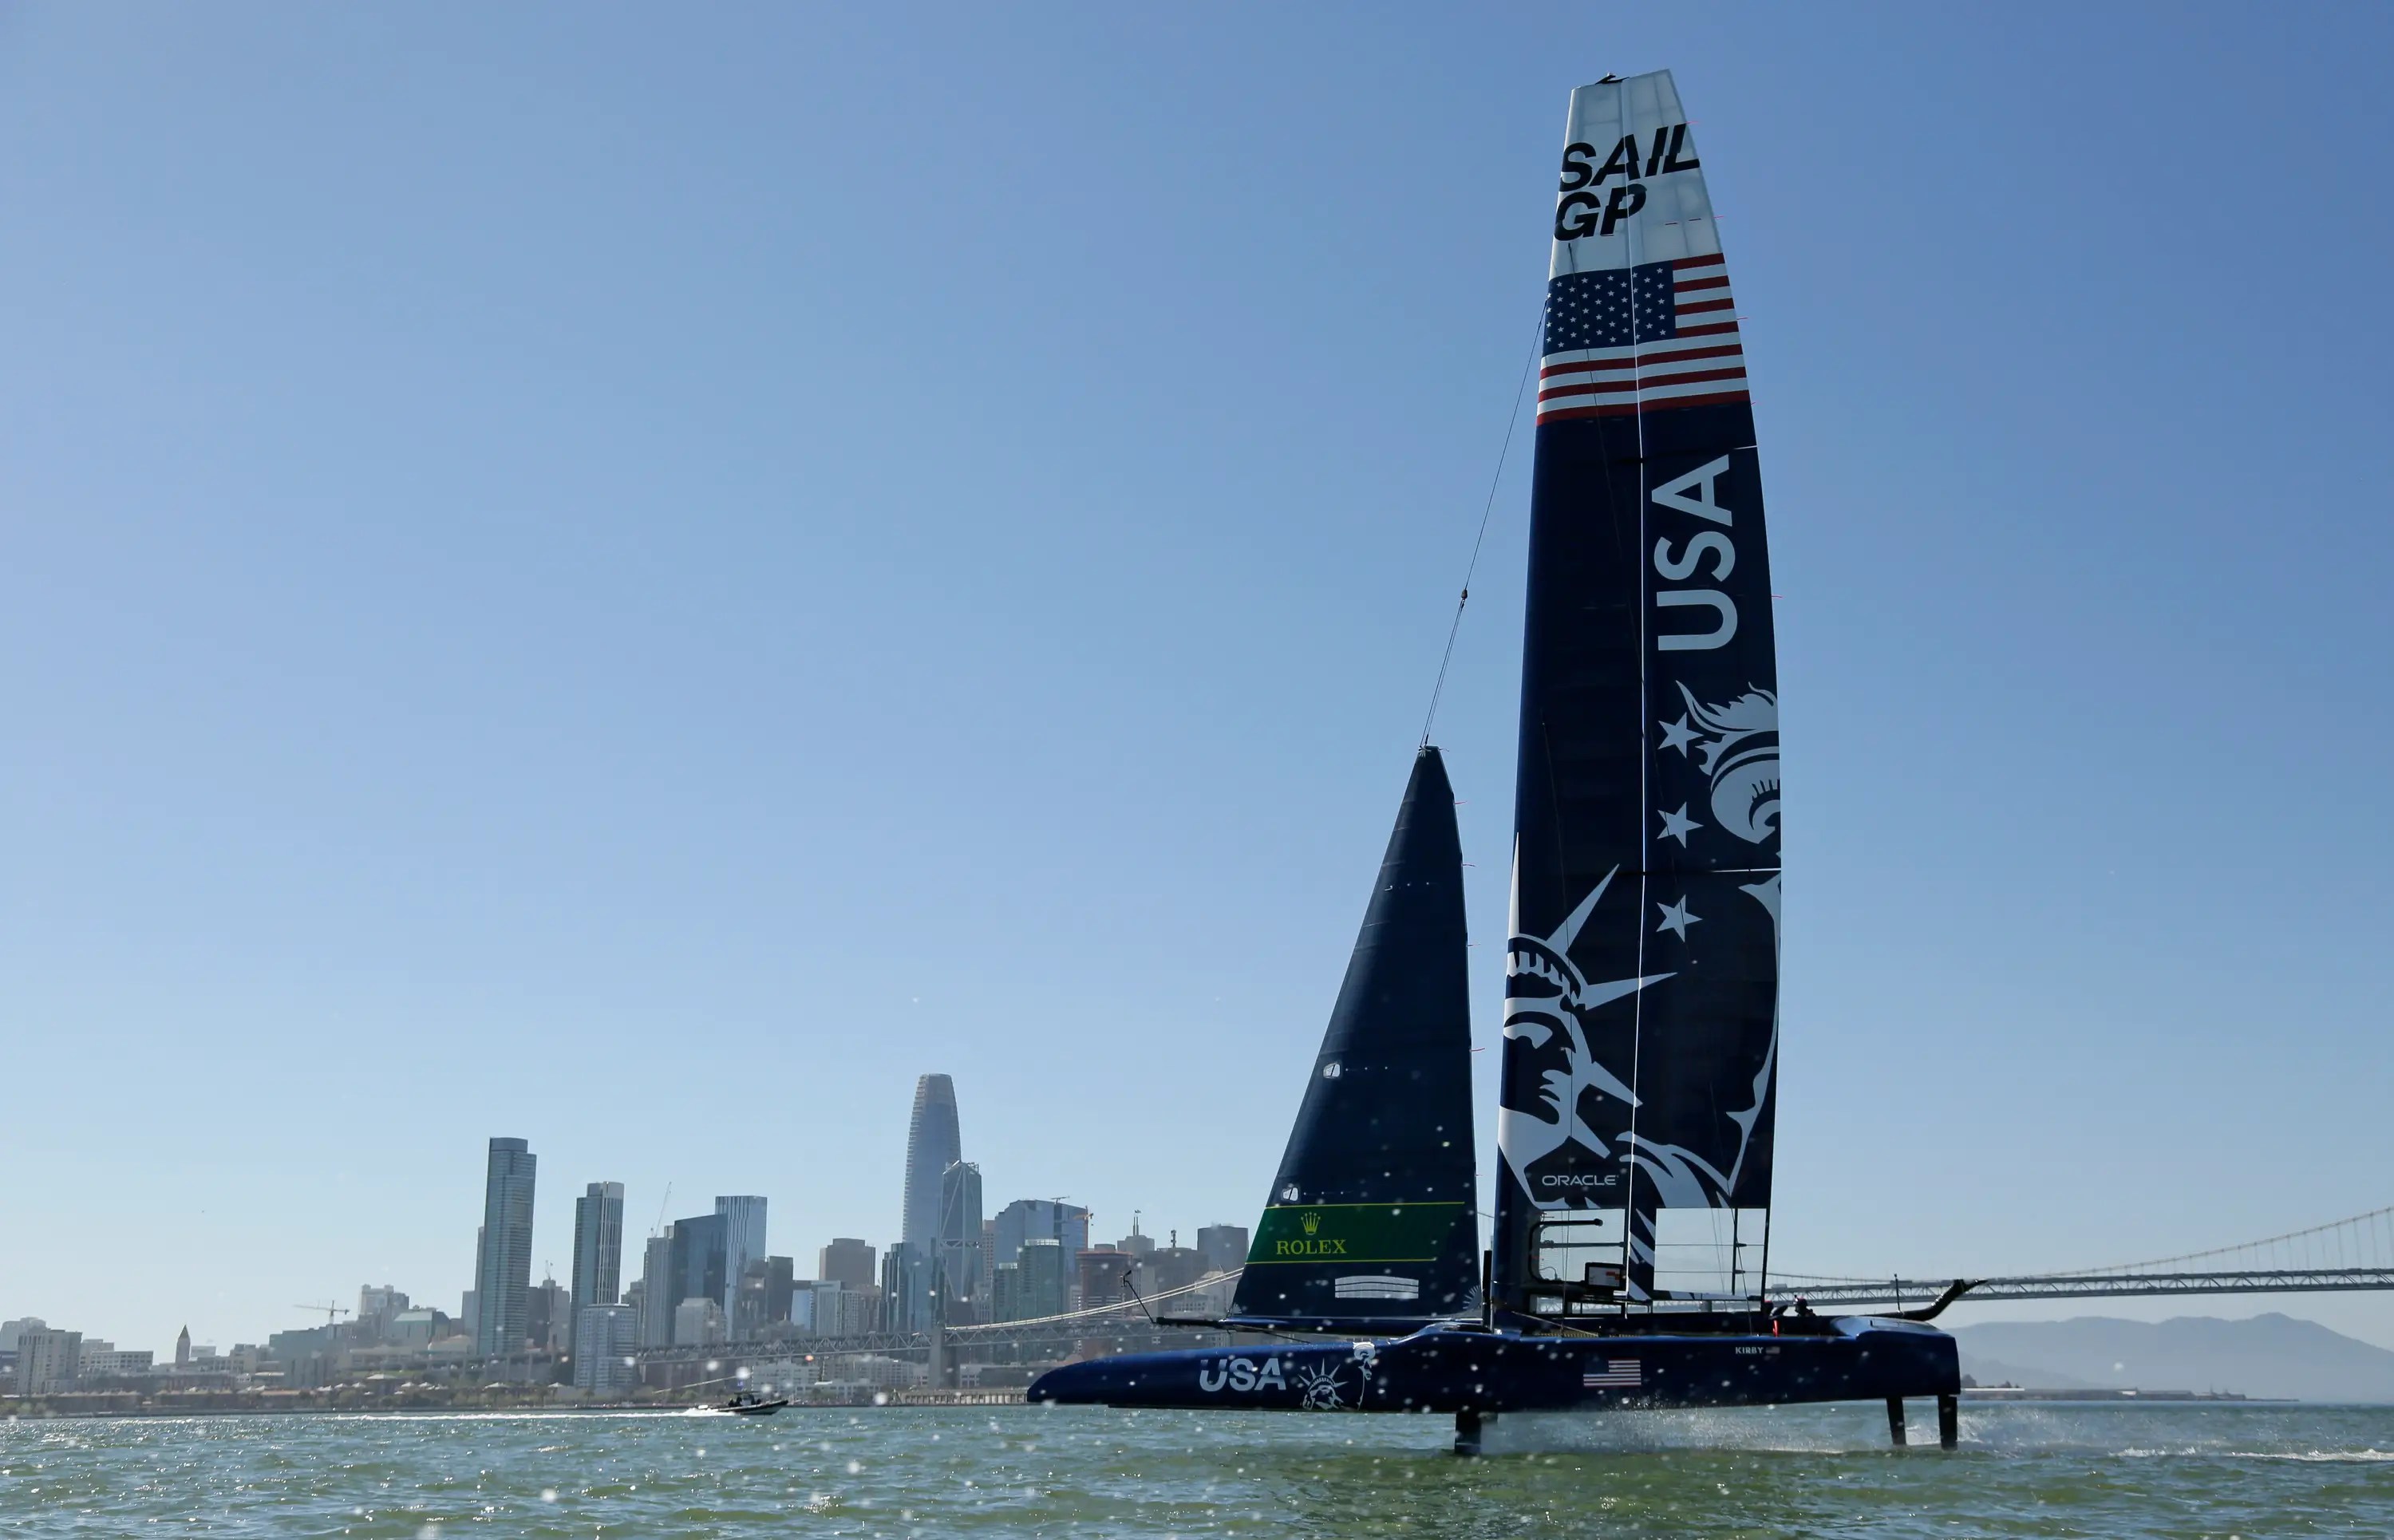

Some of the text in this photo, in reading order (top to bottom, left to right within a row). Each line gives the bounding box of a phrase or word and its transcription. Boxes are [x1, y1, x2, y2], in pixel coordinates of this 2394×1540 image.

[1559, 123, 1700, 192] SAIL
[1555, 183, 1647, 241] GP
[1651, 453, 1738, 651] USA
[1542, 1175, 1616, 1186] ORACLE
[1276, 1239, 1347, 1254] ROLEX
[1199, 1357, 1286, 1392] USA
